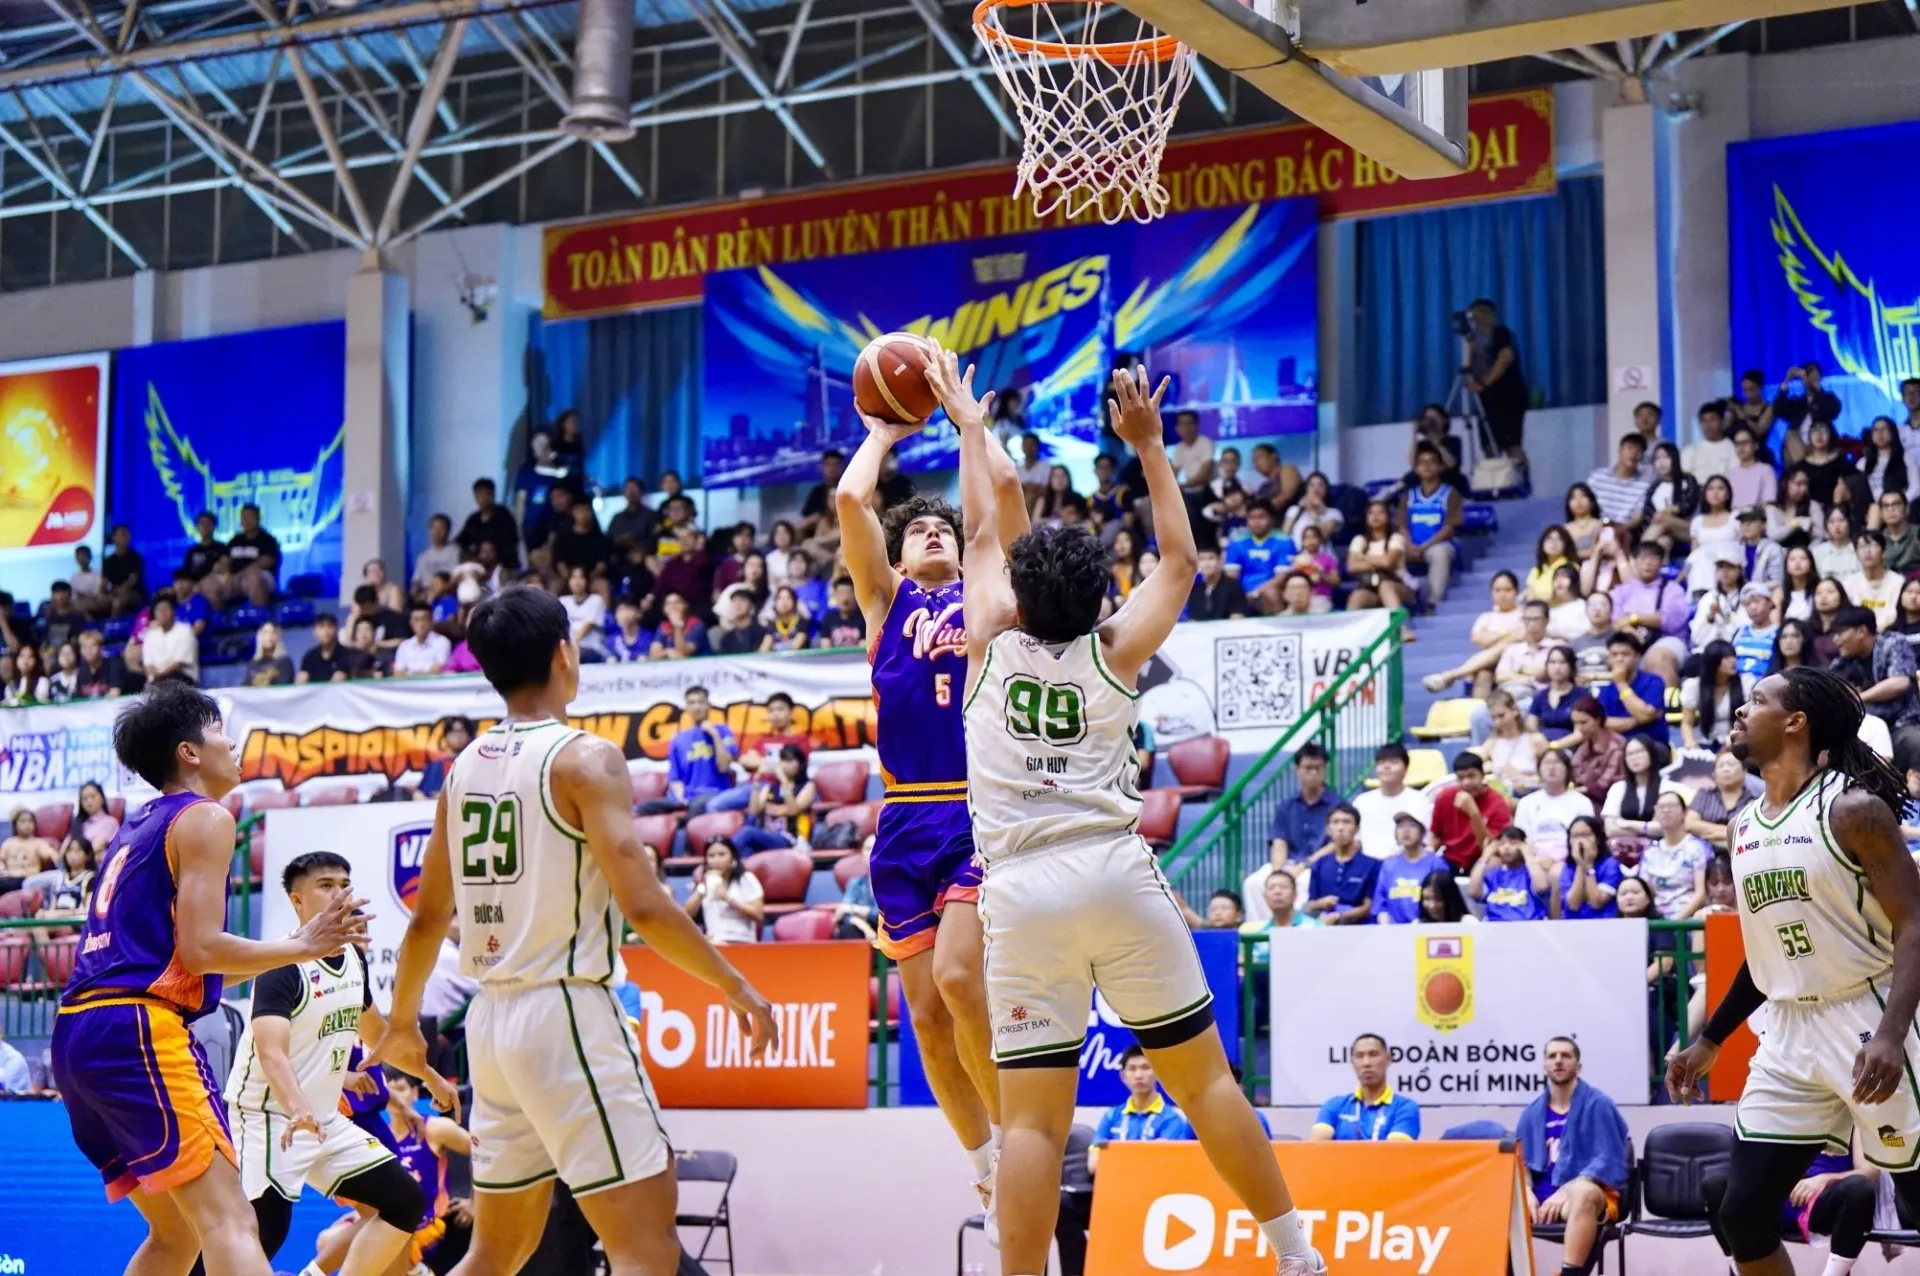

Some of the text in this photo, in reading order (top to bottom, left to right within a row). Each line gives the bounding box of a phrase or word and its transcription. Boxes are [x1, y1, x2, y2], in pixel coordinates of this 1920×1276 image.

[1275, 140, 1343, 197] BÁC
[935, 673, 952, 707] 5
[1006, 677, 1084, 742] 99
[1026, 756, 1068, 773] GIA HUY
[461, 797, 521, 881] 29
[1745, 840, 1760, 851] MSB
[1792, 835, 1813, 844] TikTok
[1775, 921, 1814, 959] 55
[997, 1018, 1051, 1035] FOREST BAY
[1467, 1039, 1536, 1062] BÓNG
[1398, 1066, 1548, 1092] HỒ CHÍ MINH
[1334, 1211, 1451, 1274] Play
[0, 1253, 25, 1275] òn
